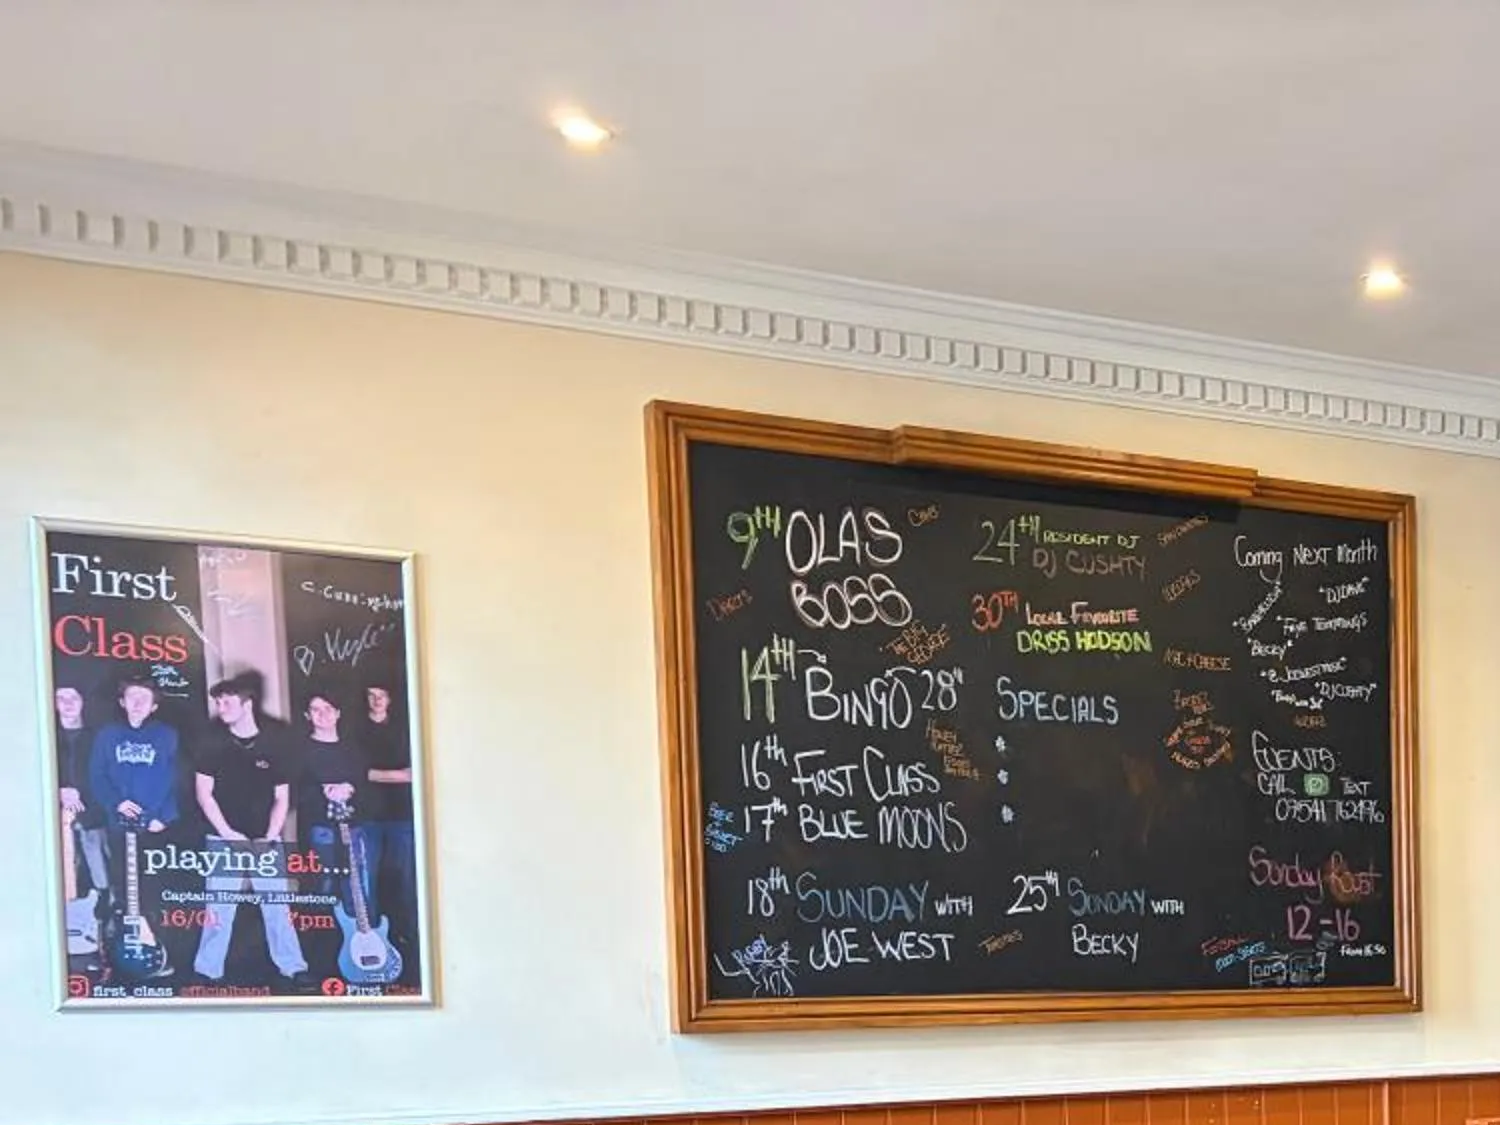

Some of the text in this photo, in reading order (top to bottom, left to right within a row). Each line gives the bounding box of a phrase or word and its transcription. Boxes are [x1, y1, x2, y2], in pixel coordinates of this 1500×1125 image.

[1032, 547, 1057, 578] DJ
[1117, 533, 1142, 549] DJ
[51, 552, 177, 601] First
[54, 614, 188, 663] Class
[995, 675, 1120, 726] SPECIALS
[144, 844, 279, 877] playing
[796, 871, 929, 923] SUNDAY
[1067, 877, 1148, 918] SUNDAY
[808, 927, 870, 971] JOE
[871, 930, 955, 962] WEST
